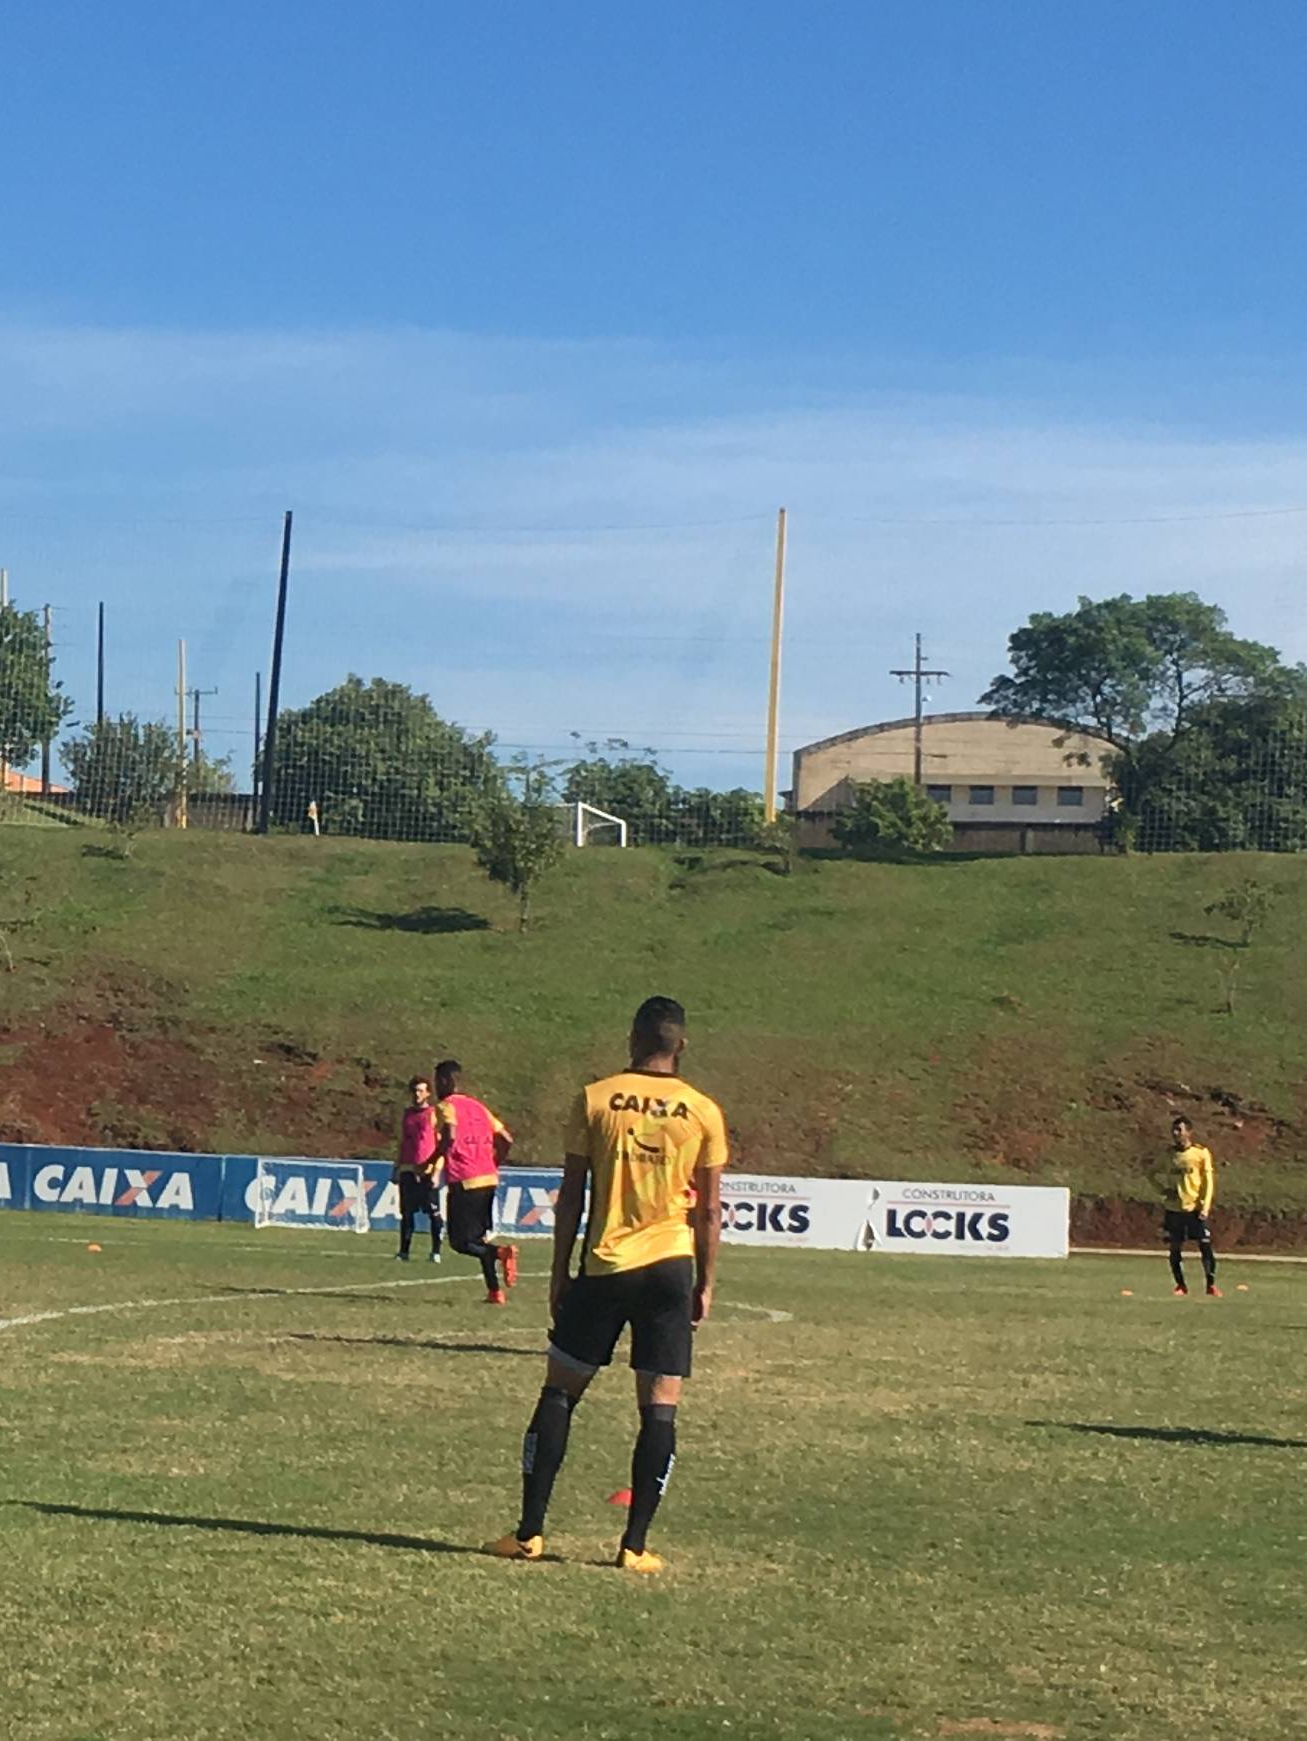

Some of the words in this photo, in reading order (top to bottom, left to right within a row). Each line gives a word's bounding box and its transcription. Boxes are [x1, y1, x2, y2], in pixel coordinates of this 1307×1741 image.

[609, 1092, 689, 1120] CAIXA
[33, 1164, 194, 1211] CAIXA
[902, 1187, 995, 1202] CONSTRUTORA
[886, 1208, 1010, 1243] LOCKS
